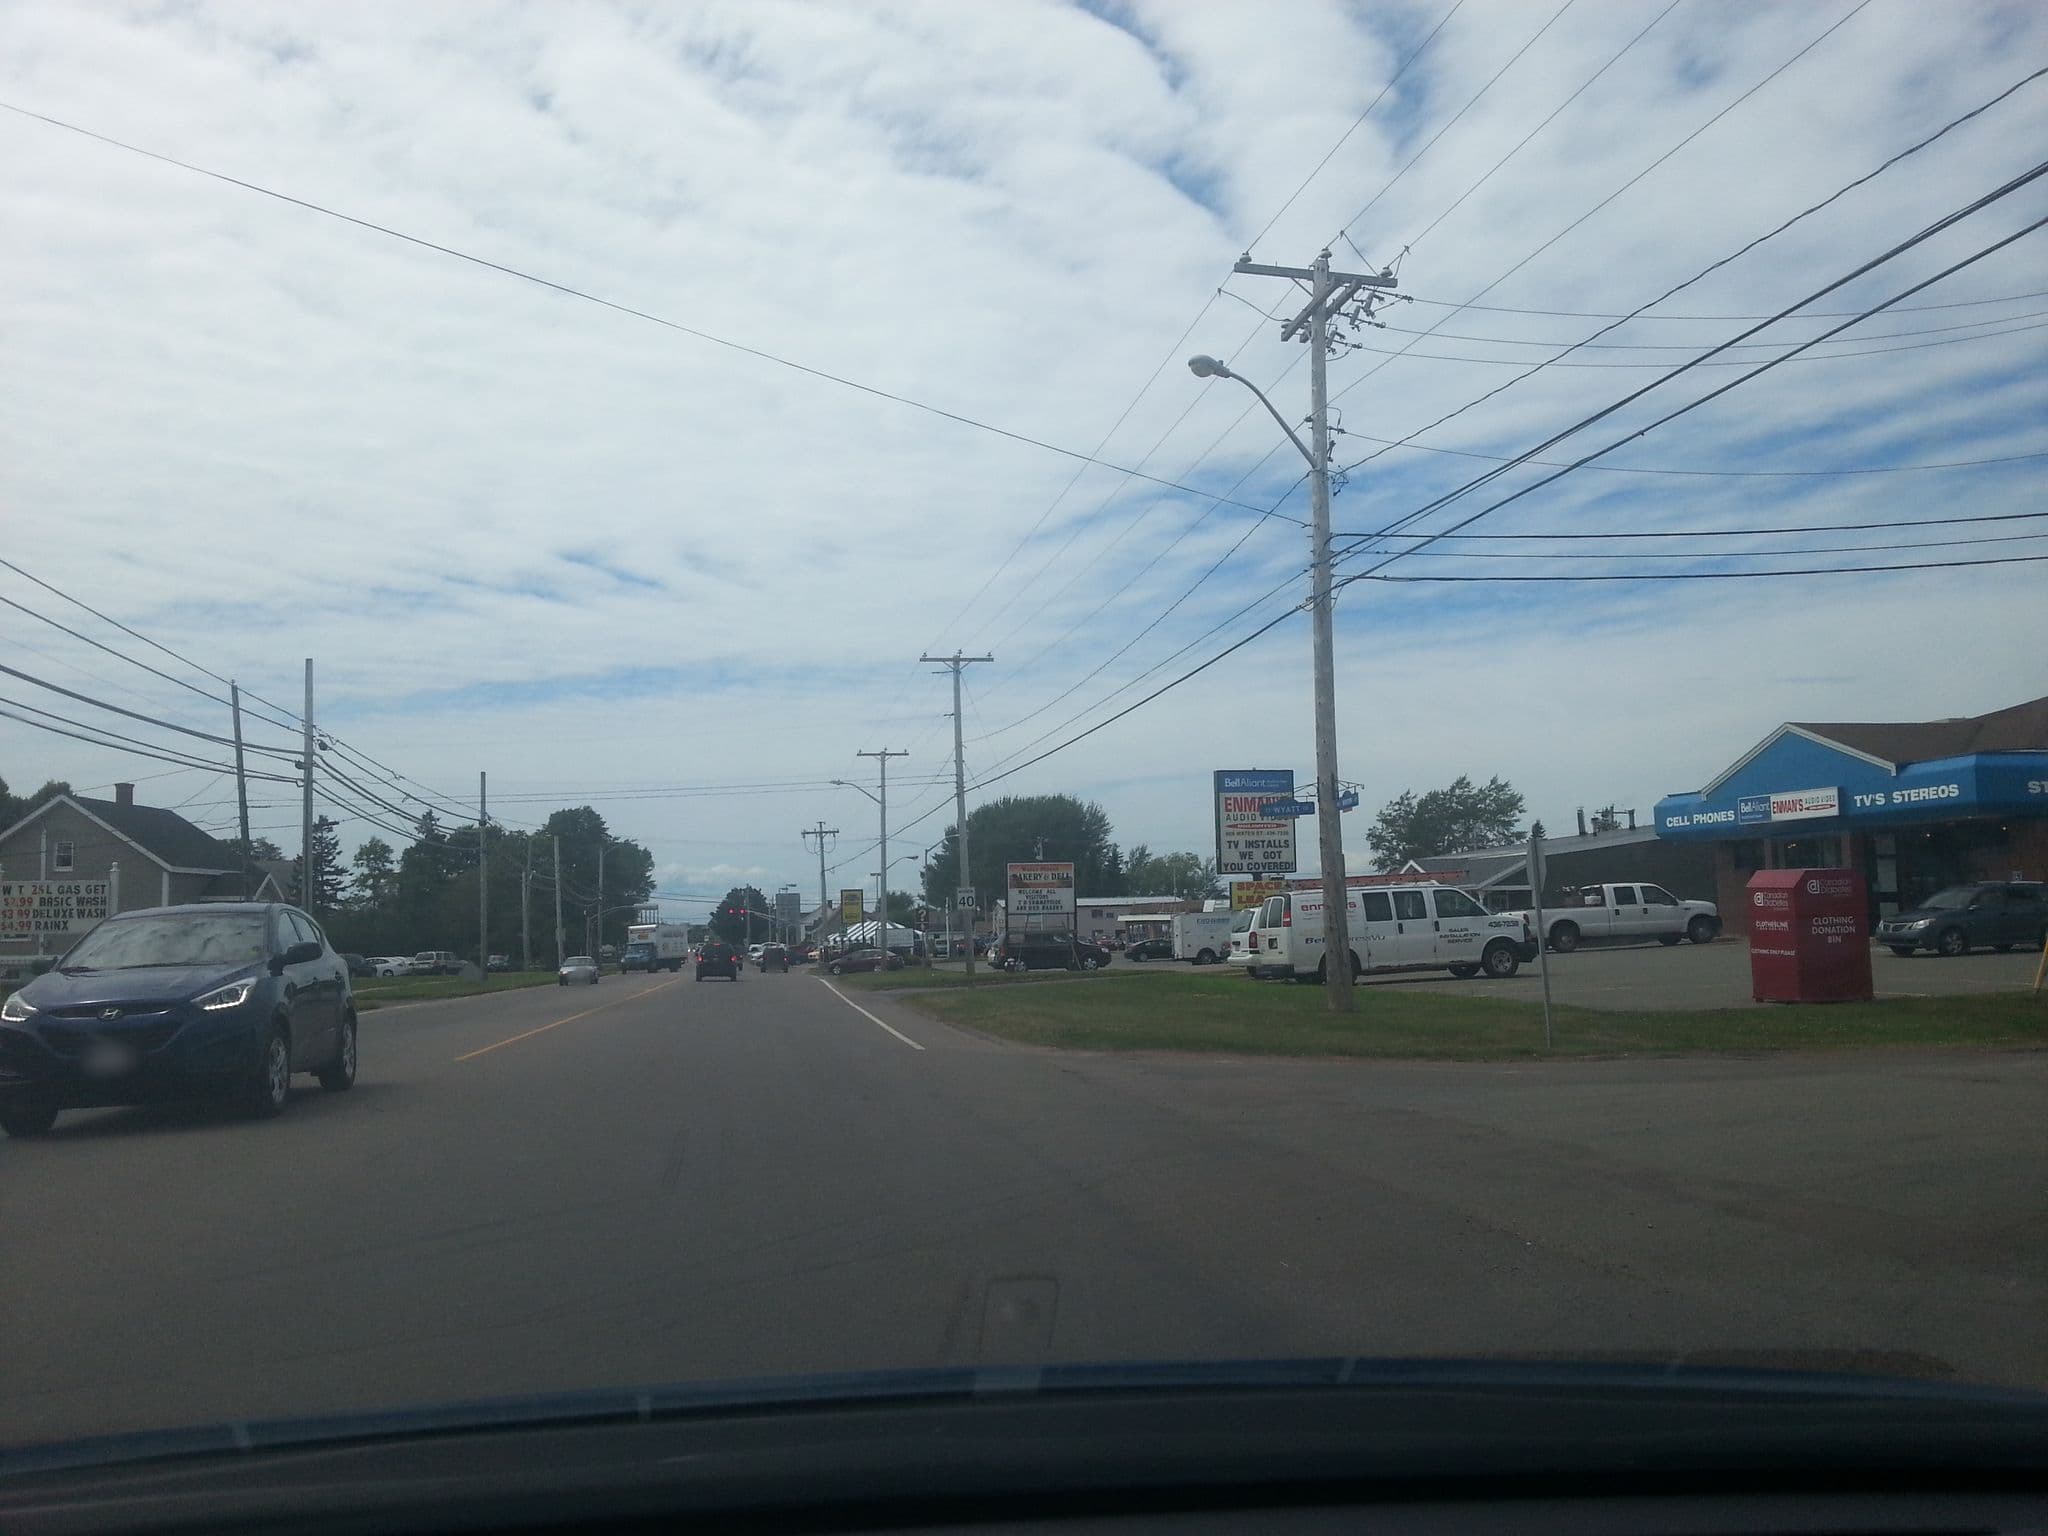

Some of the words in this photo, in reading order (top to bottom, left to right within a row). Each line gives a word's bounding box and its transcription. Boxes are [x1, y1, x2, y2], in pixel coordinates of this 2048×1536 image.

[1854, 793, 1886, 807] TV'S
[1892, 784, 1960, 804] STEREOS
[1772, 799, 1805, 815] ENMAN'S
[1226, 813, 1257, 821] AUDIO
[1666, 815, 1691, 828] CELL
[1693, 810, 1736, 825] PHONES
[1227, 840, 1240, 850] TV
[1245, 839, 1290, 849] INSTALLS
[1239, 851, 1255, 861] WE
[1263, 850, 1283, 860] GOT
[1223, 863, 1244, 872] YOU
[1247, 861, 1294, 871] COVERED!
[57, 884, 81, 895] GAS
[84, 884, 107, 895] GET
[39, 896, 72, 907] BASIC
[76, 896, 107, 906] WASH
[958, 896, 975, 907] 40
[32, 908, 75, 919] DELUXE
[76, 908, 107, 919] WASH
[34, 920, 70, 930] RAINX
[1812, 916, 1854, 925] CLOTHING
[1811, 926, 1856, 935] DONATION
[1827, 935, 1842, 944] BIN
